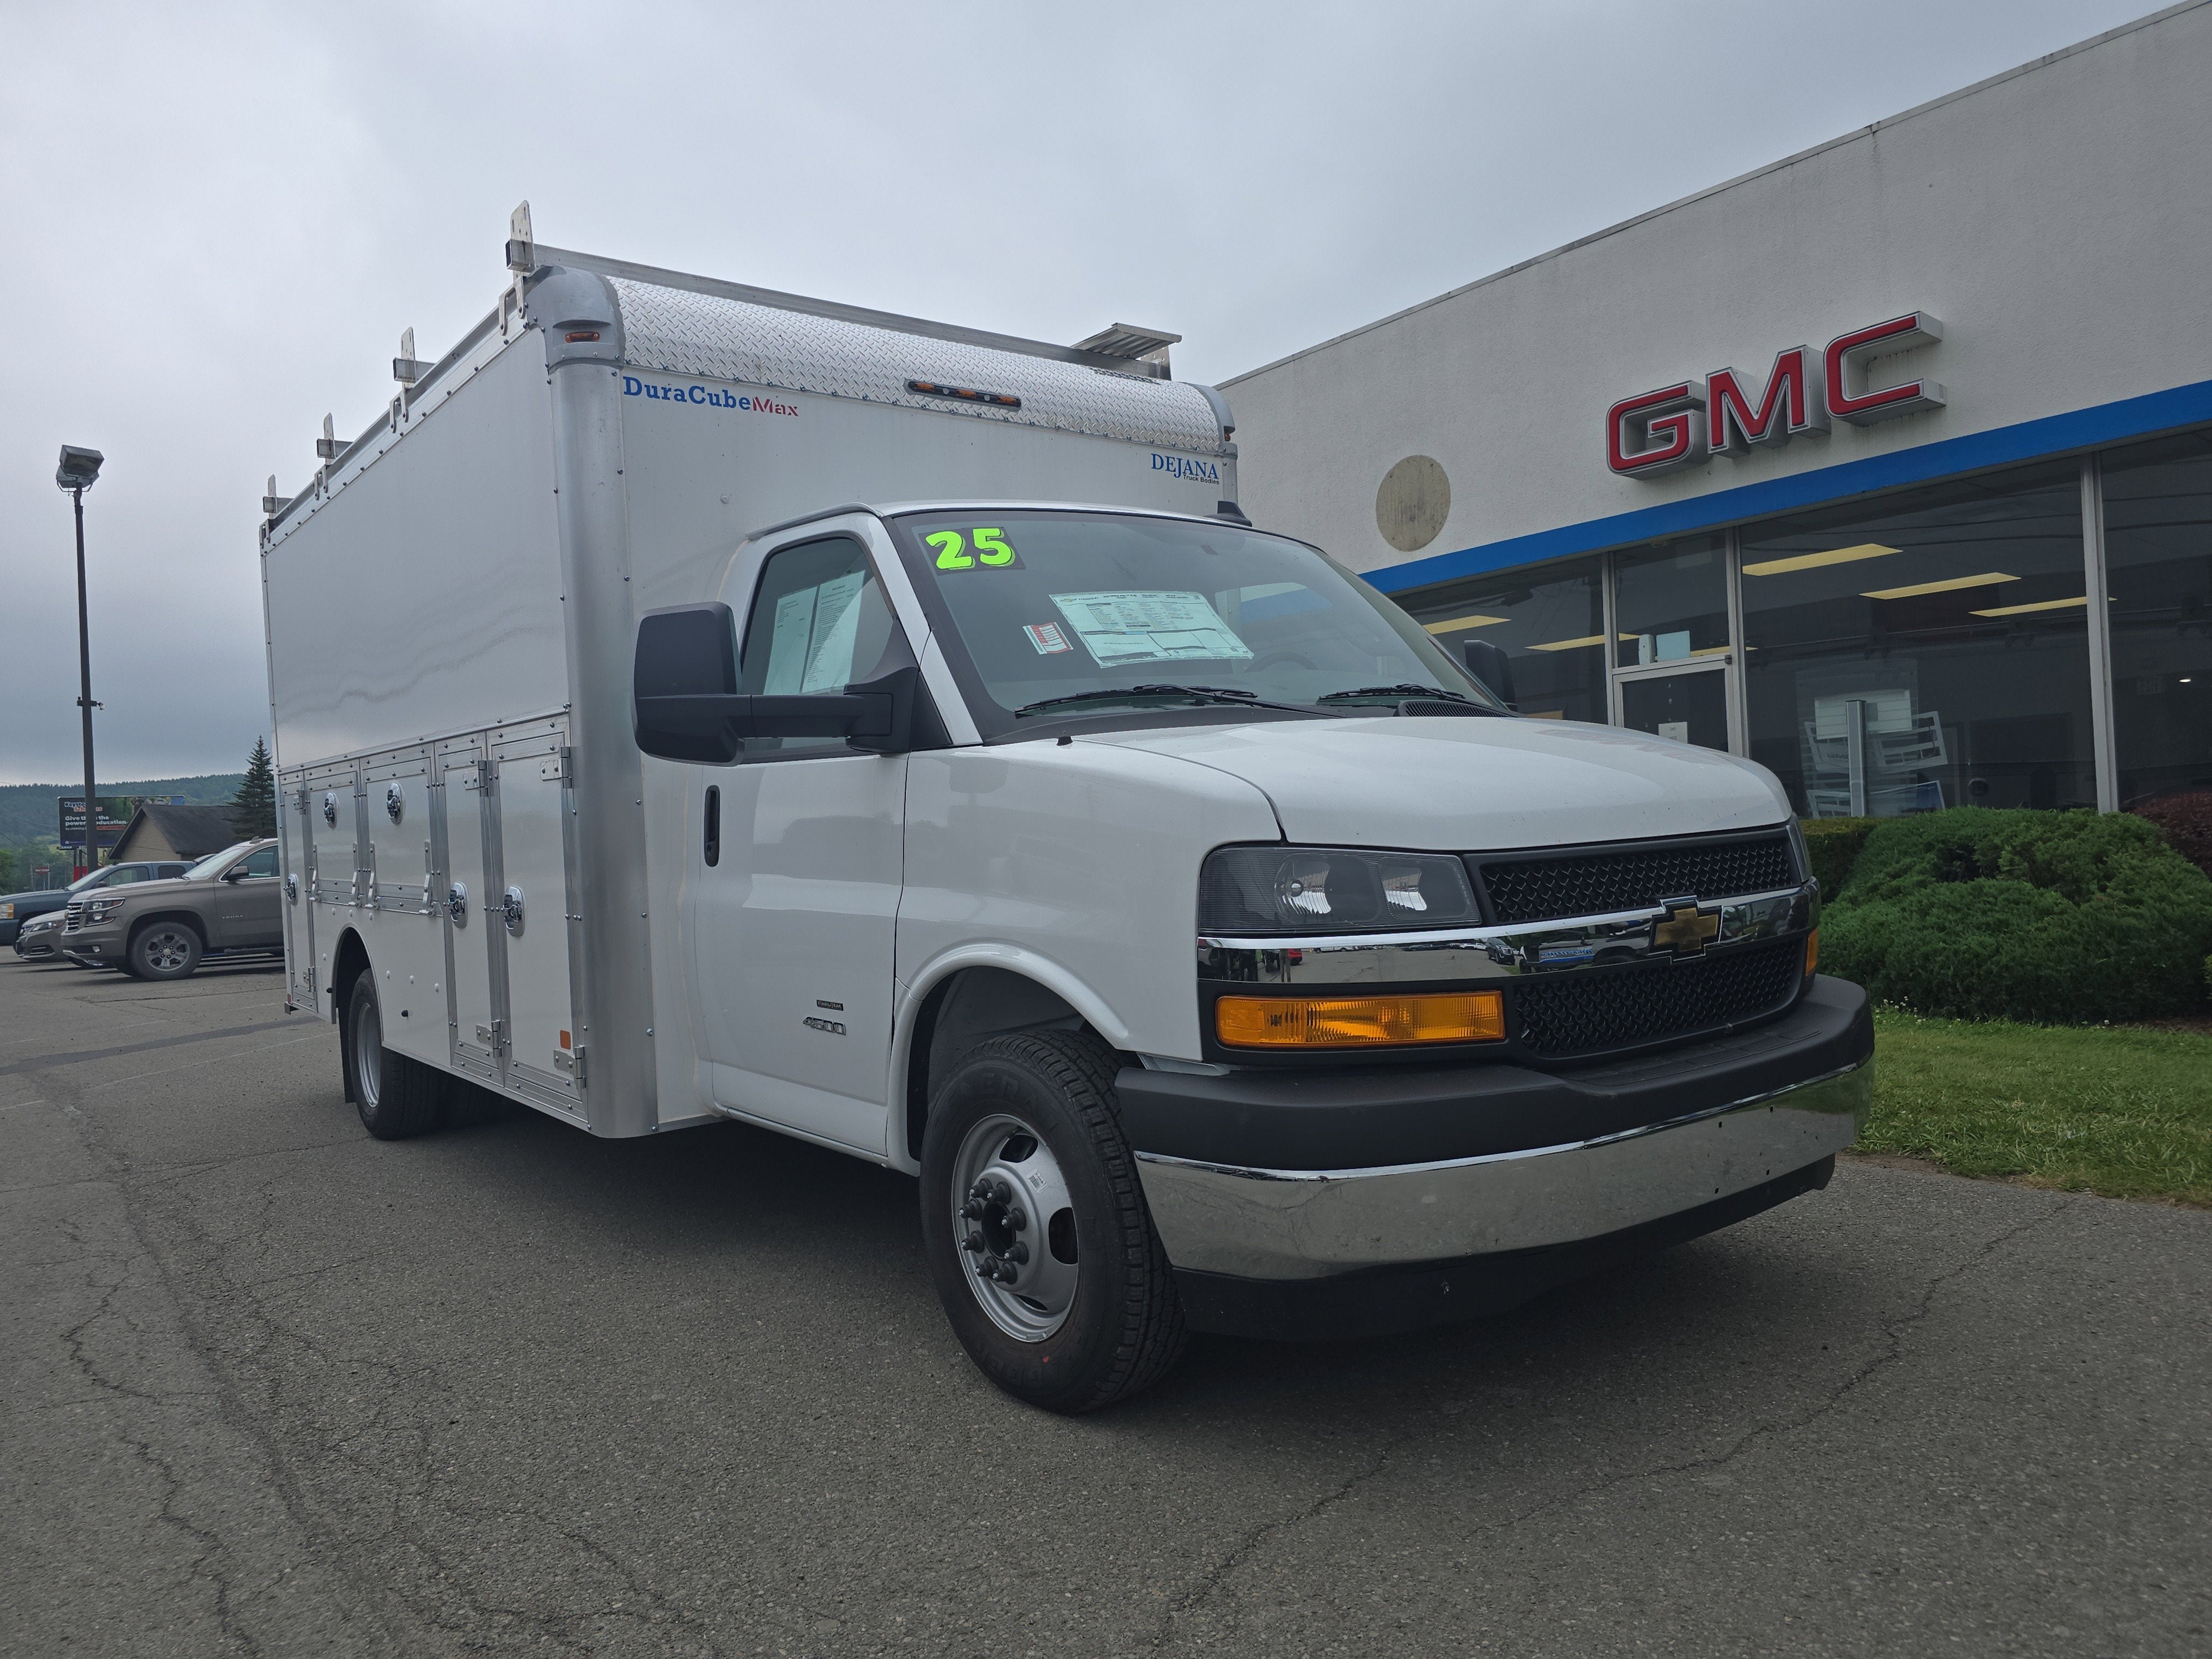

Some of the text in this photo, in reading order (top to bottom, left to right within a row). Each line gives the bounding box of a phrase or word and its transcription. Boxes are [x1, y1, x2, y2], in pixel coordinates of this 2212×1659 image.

[1605, 311, 1935, 477] GMC
[1150, 453, 1219, 479] DEJANA
[925, 528, 1015, 570] 25
[803, 1017, 847, 1036] 4500
